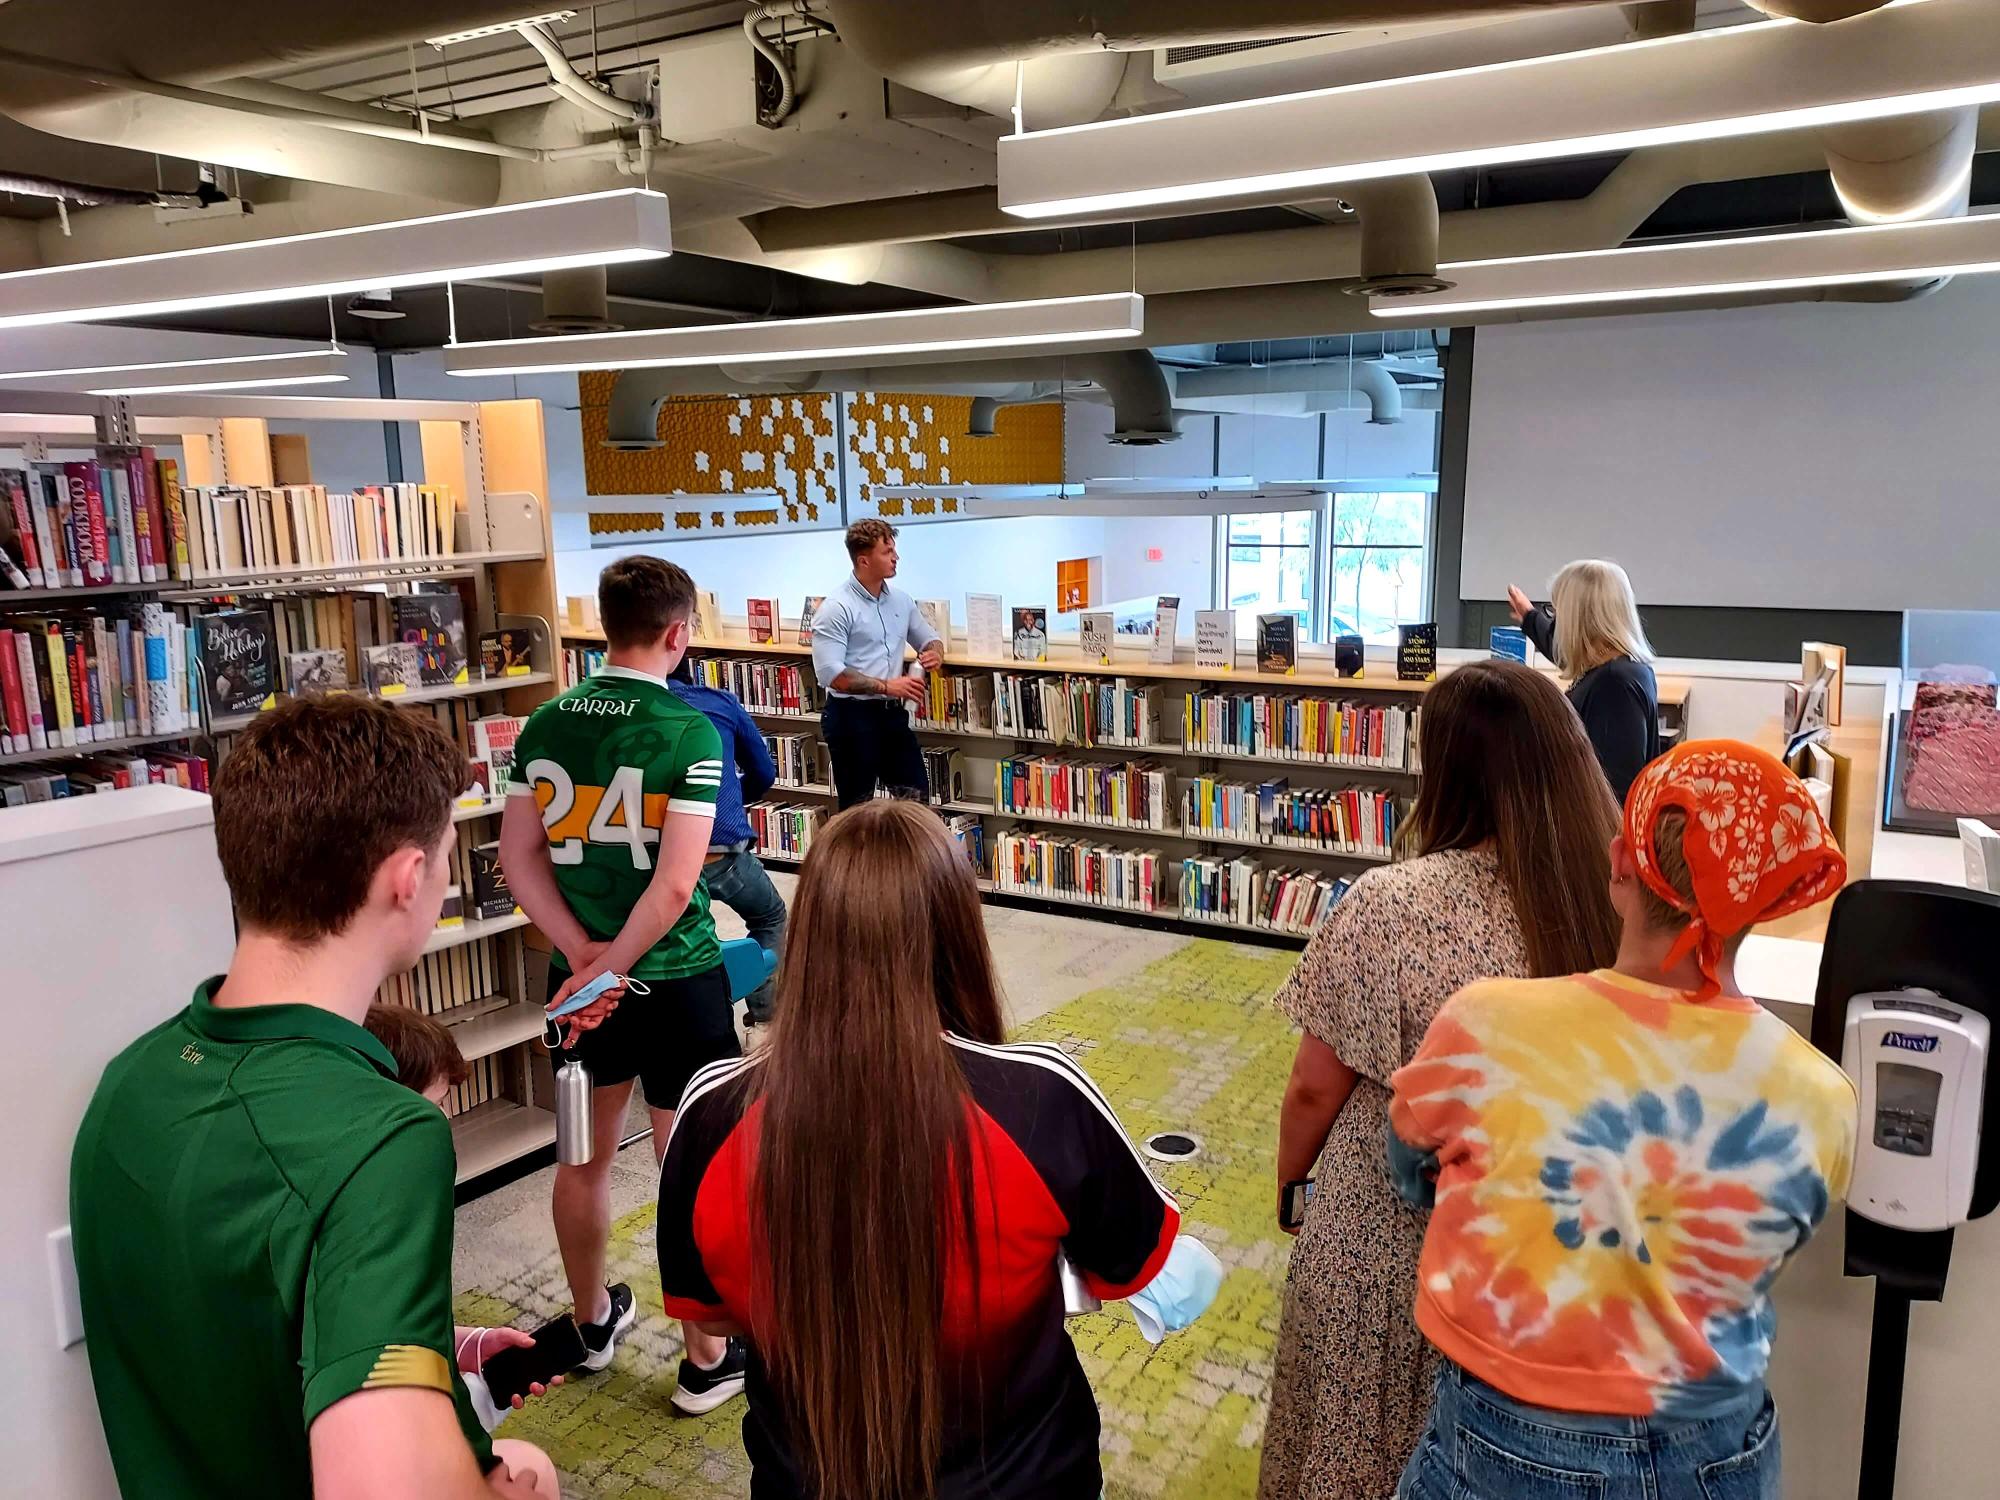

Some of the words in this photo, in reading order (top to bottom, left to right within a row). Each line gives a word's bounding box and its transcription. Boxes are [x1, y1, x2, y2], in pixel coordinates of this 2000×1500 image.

[70, 477, 93, 564] COOKBOOK
[1082, 632, 1106, 643] RUSH
[220, 633, 266, 662] Holiday
[1403, 647, 1431, 655] UNIVERSE
[1415, 656, 1431, 664] STARS
[559, 697, 640, 716] CIARRAÍ
[525, 758, 660, 870] 24
[483, 898, 508, 907] MICHAEL
[180, 1041, 204, 1064] Éire
